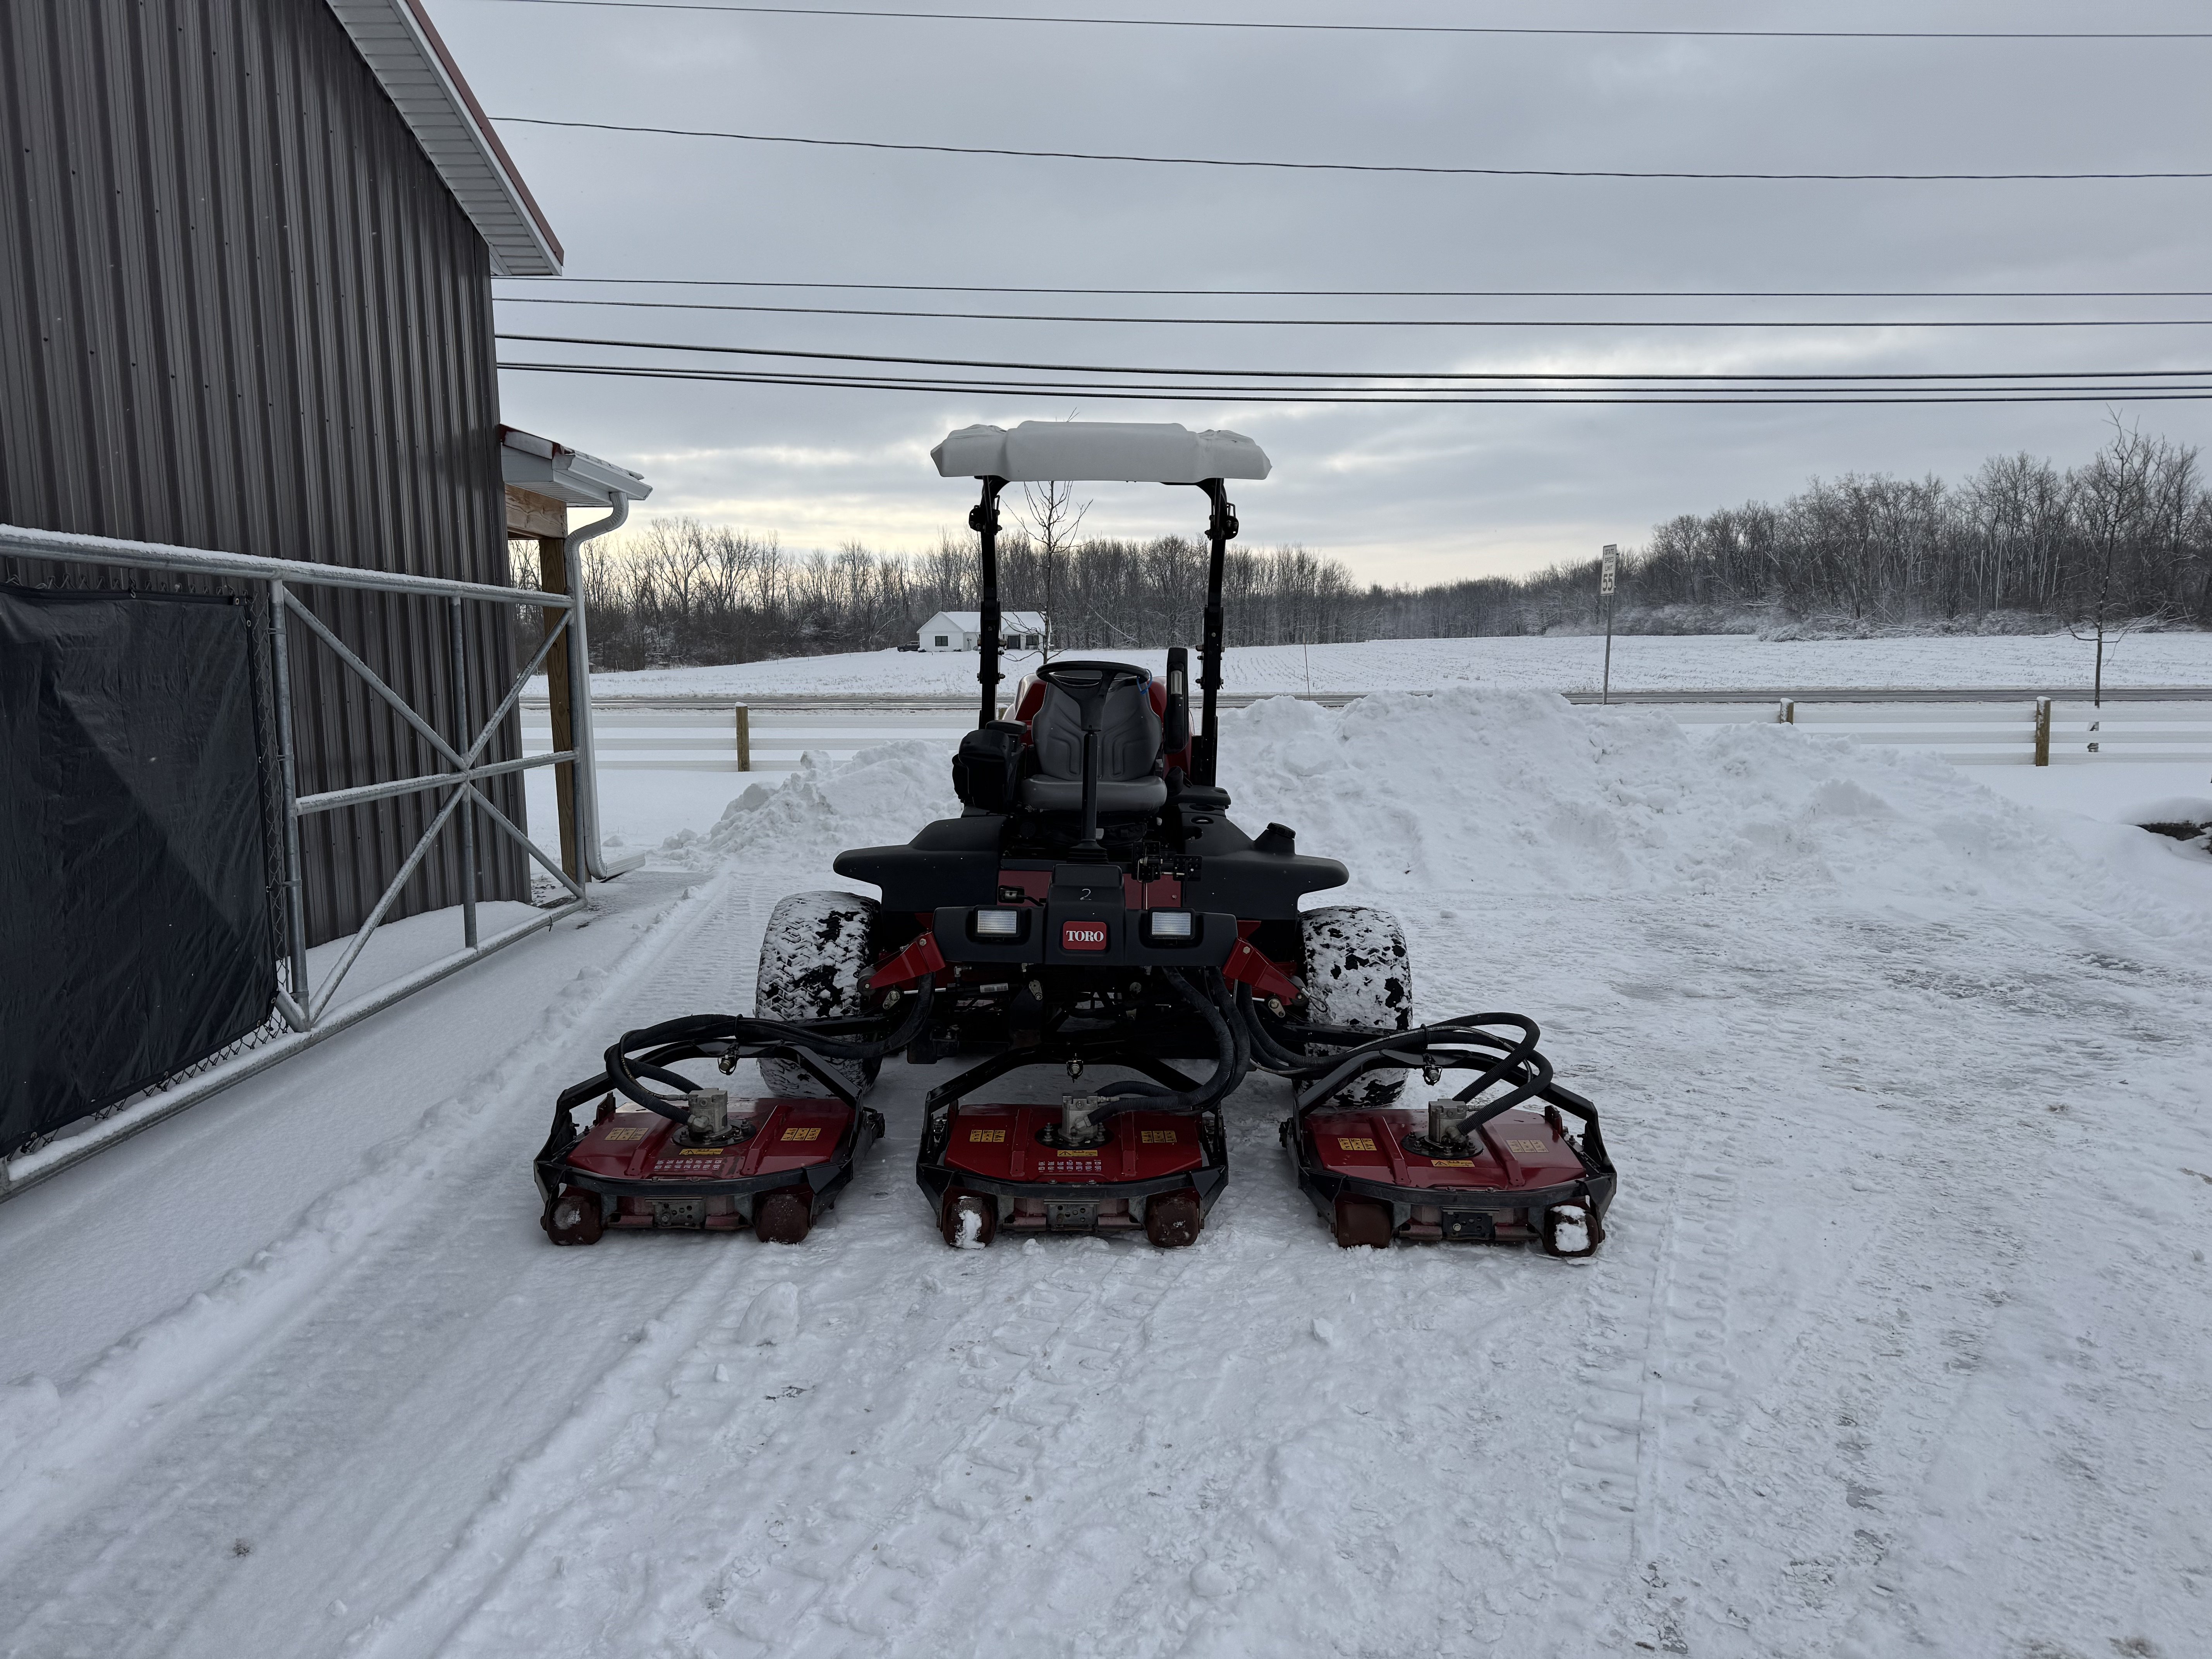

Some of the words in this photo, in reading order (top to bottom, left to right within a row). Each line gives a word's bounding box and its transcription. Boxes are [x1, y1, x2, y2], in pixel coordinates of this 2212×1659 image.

[1602, 573, 1613, 591] 55
[1080, 888, 1092, 900] 2
[1066, 931, 1104, 942] TORO
